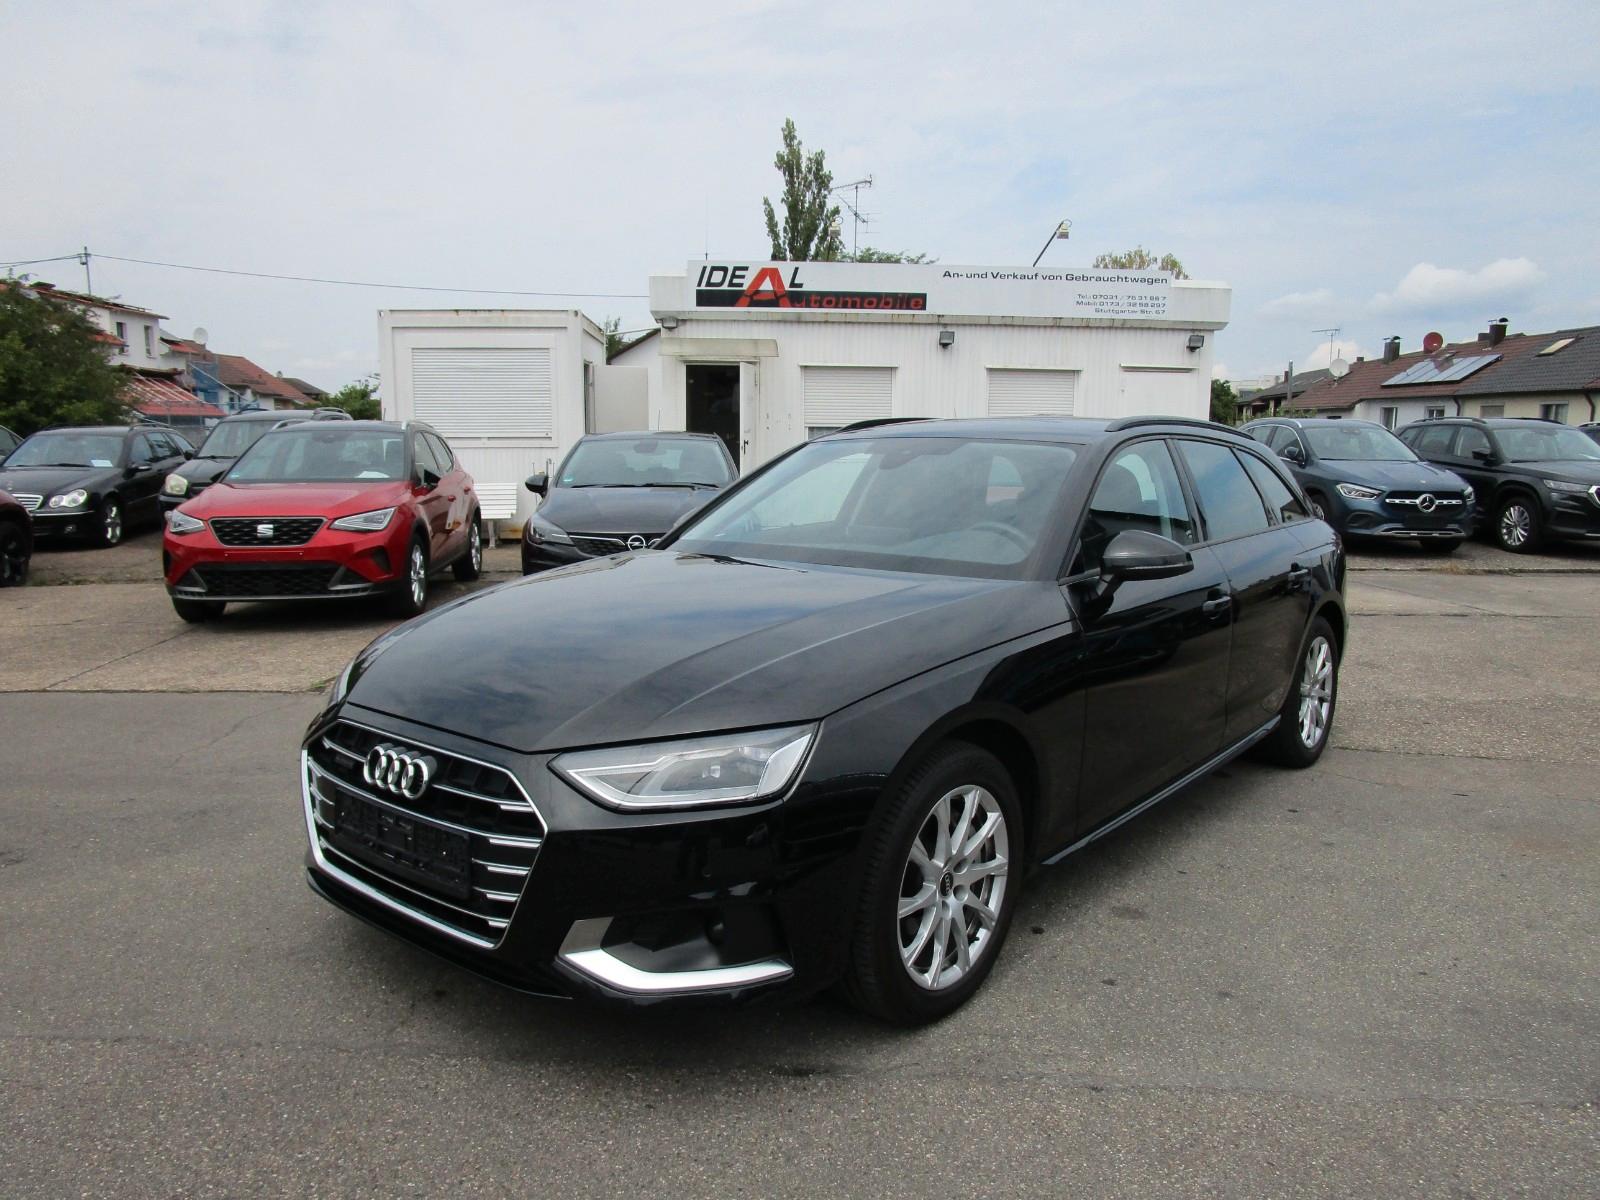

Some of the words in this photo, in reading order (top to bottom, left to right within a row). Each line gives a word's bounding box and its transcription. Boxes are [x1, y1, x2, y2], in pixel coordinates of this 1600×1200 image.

[696, 265, 804, 307] IDEAL
[966, 271, 988, 280] und
[991, 271, 1040, 281] Verkauf
[1065, 272, 1168, 285] Gebrauchtwagen
